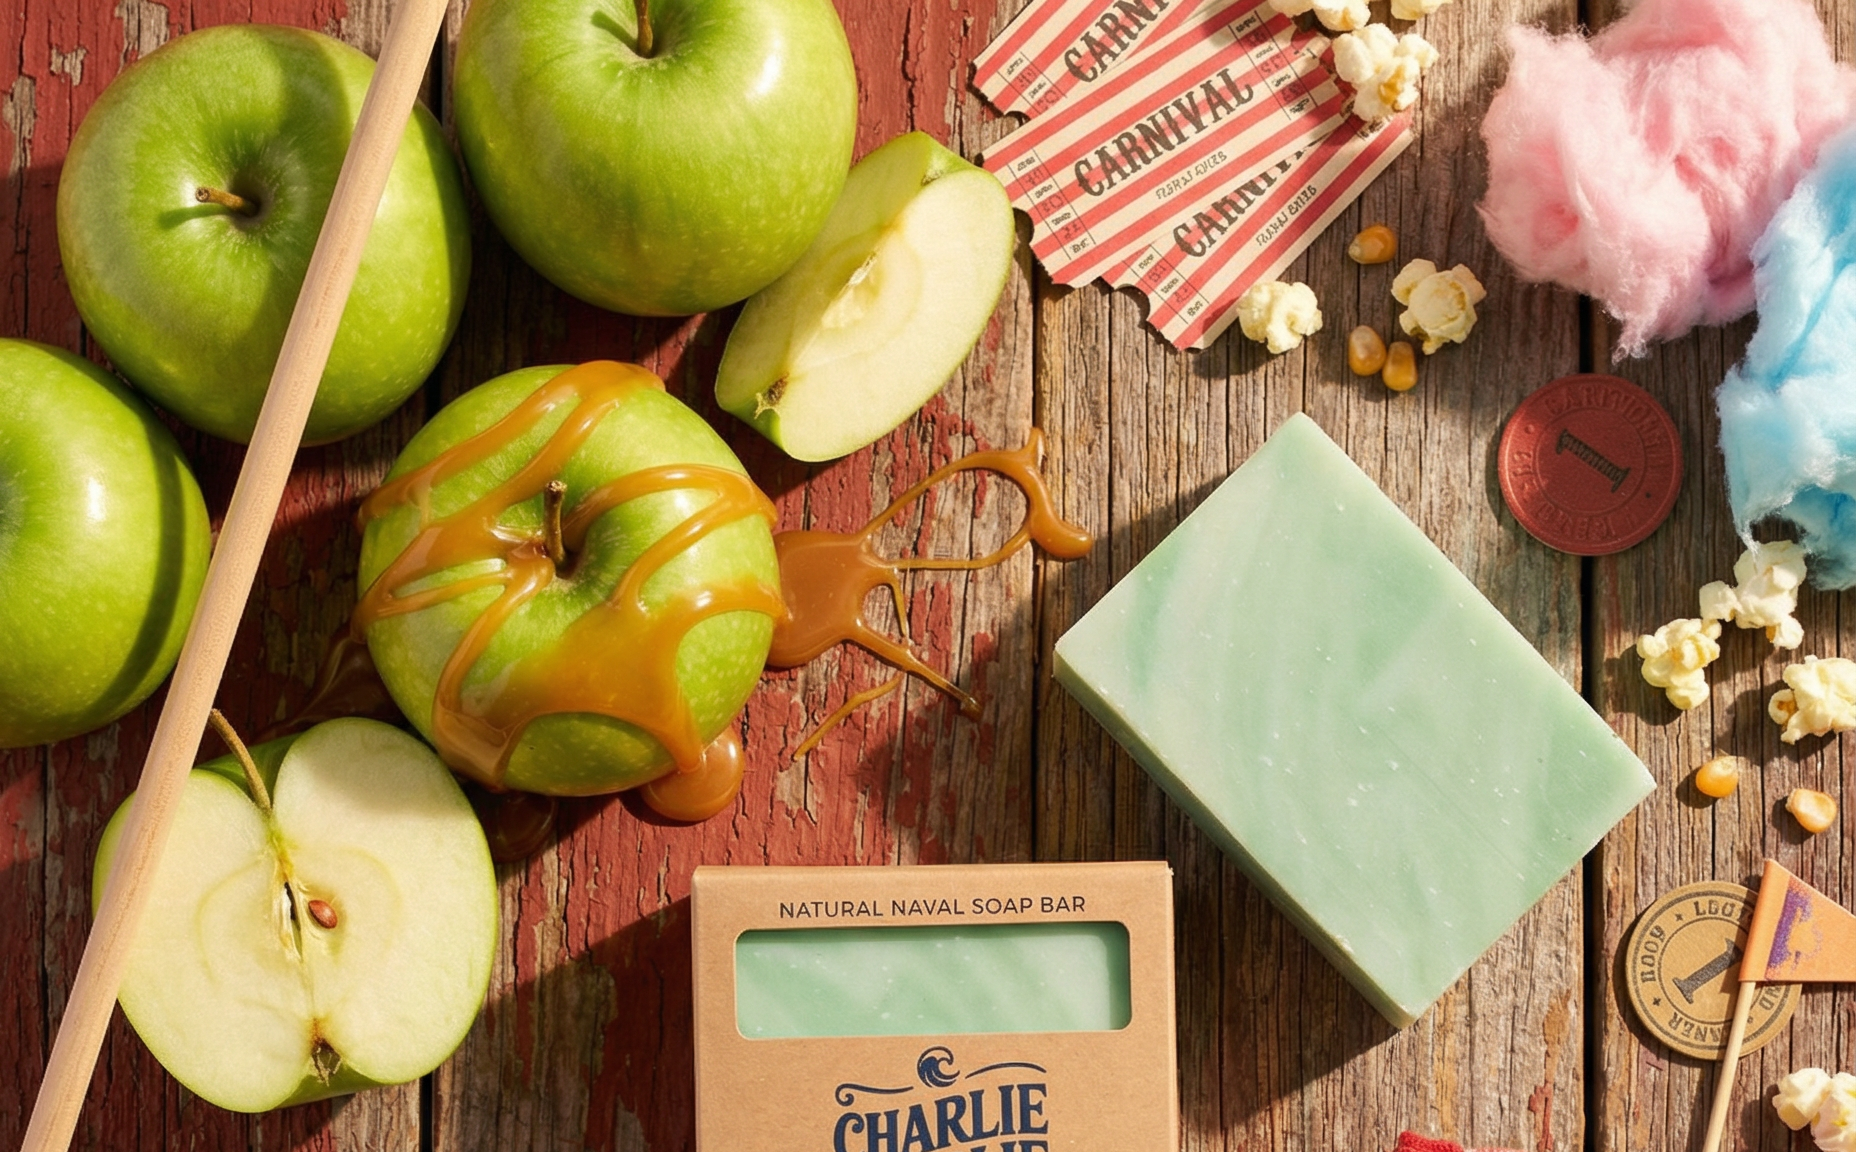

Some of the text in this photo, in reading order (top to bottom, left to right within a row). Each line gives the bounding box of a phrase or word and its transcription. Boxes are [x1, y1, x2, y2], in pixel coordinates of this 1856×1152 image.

[1074, 67, 1254, 197] CARNIVAL
[779, 896, 1085, 918] NATURAL NAVAL SOAP BAR
